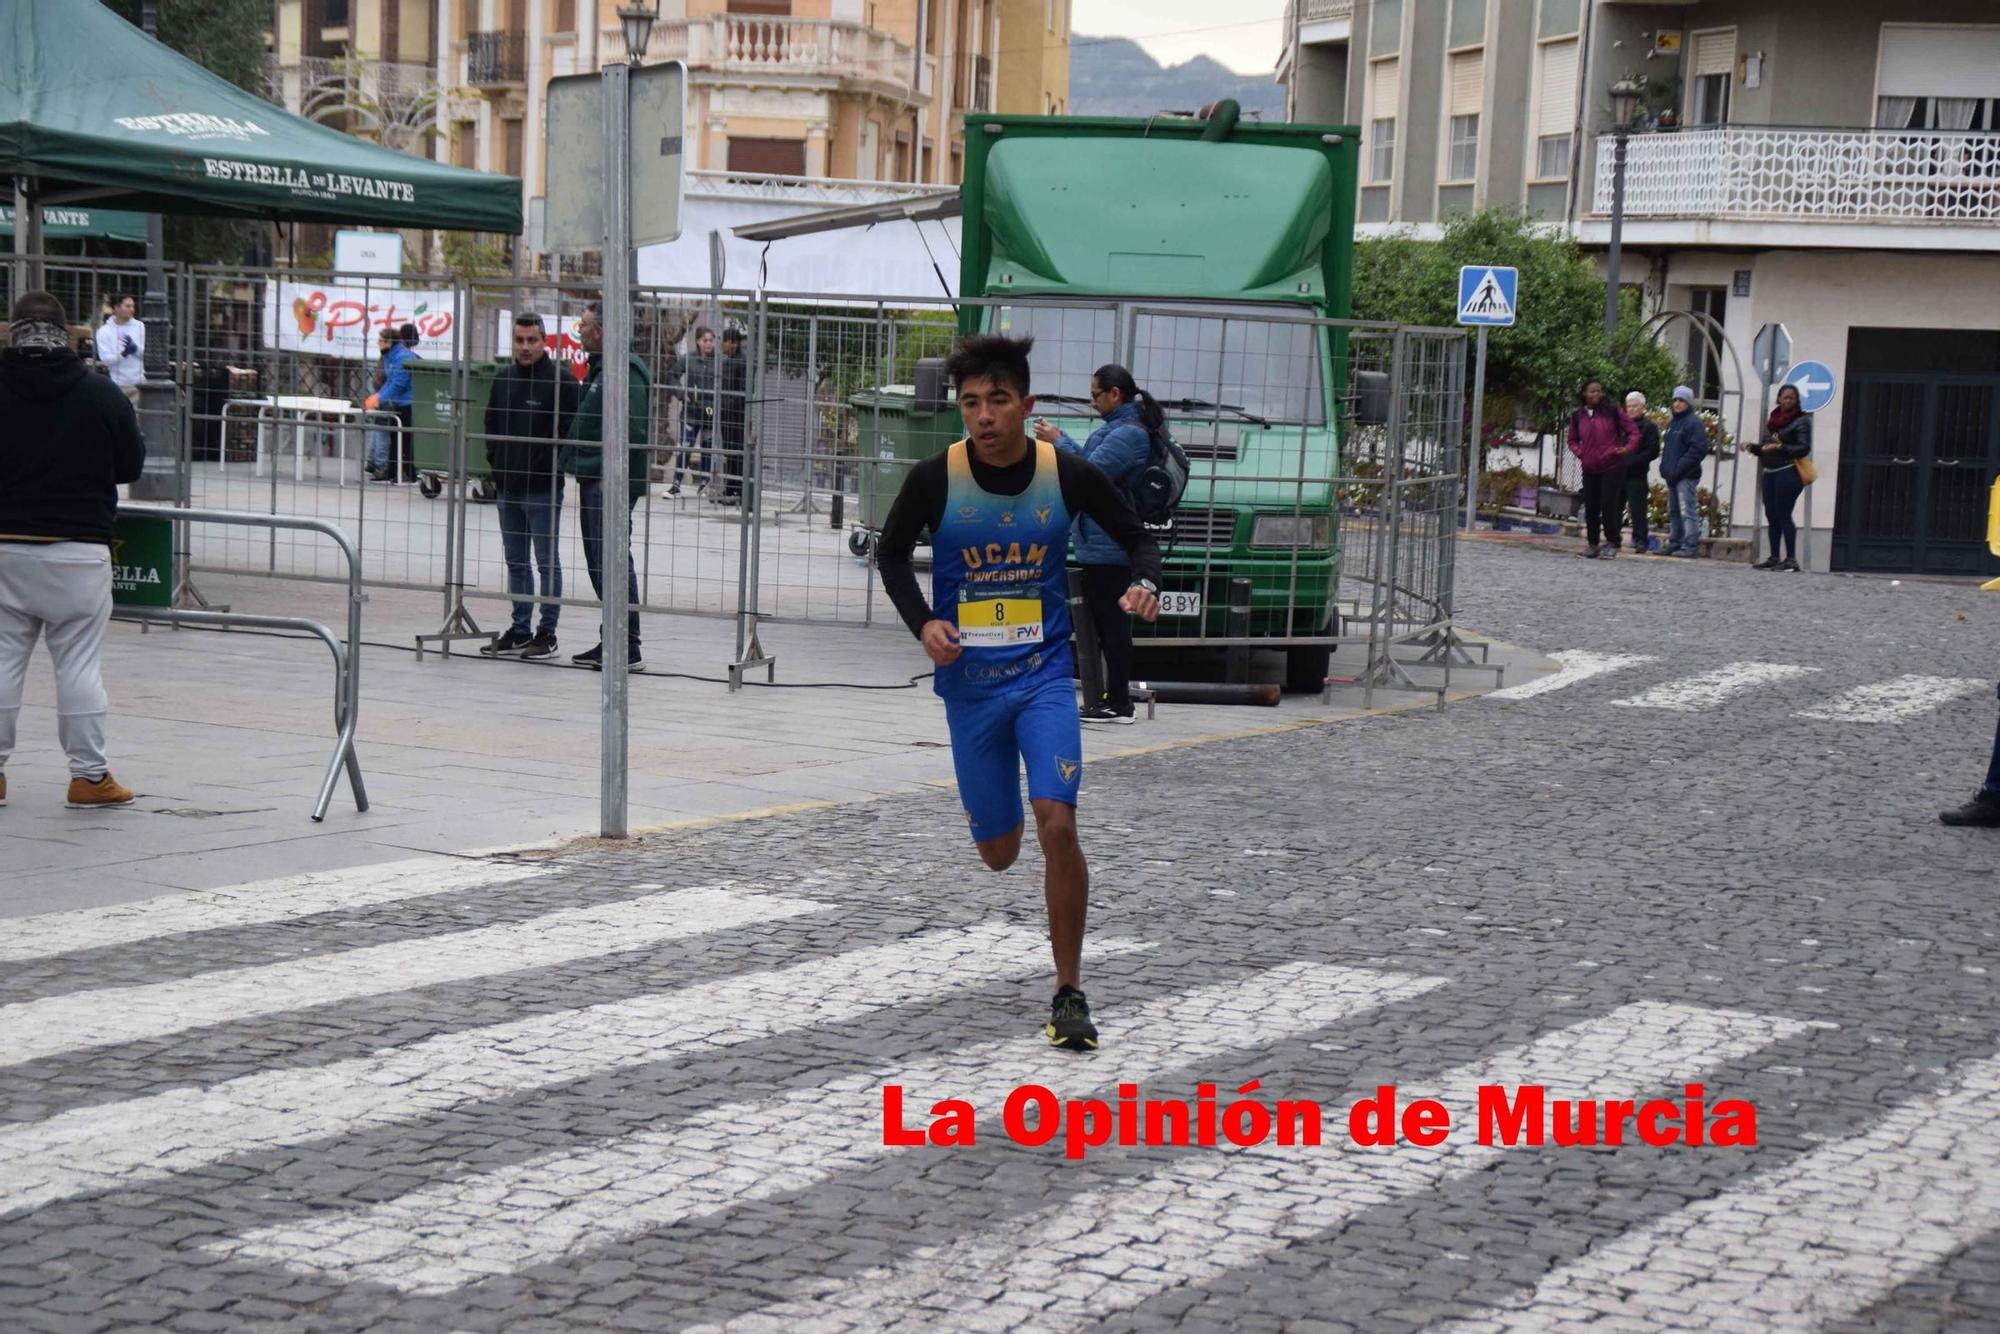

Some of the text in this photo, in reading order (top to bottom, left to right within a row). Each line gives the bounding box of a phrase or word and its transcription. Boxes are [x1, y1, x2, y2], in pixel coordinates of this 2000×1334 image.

[203, 158, 415, 202] ESTRELLA DE LEVANTE
[961, 542, 1049, 569] UCAM
[112, 565, 161, 584] ELLA
[964, 569, 1042, 582] UNIVERSIDAD
[995, 602, 1004, 621] 8
